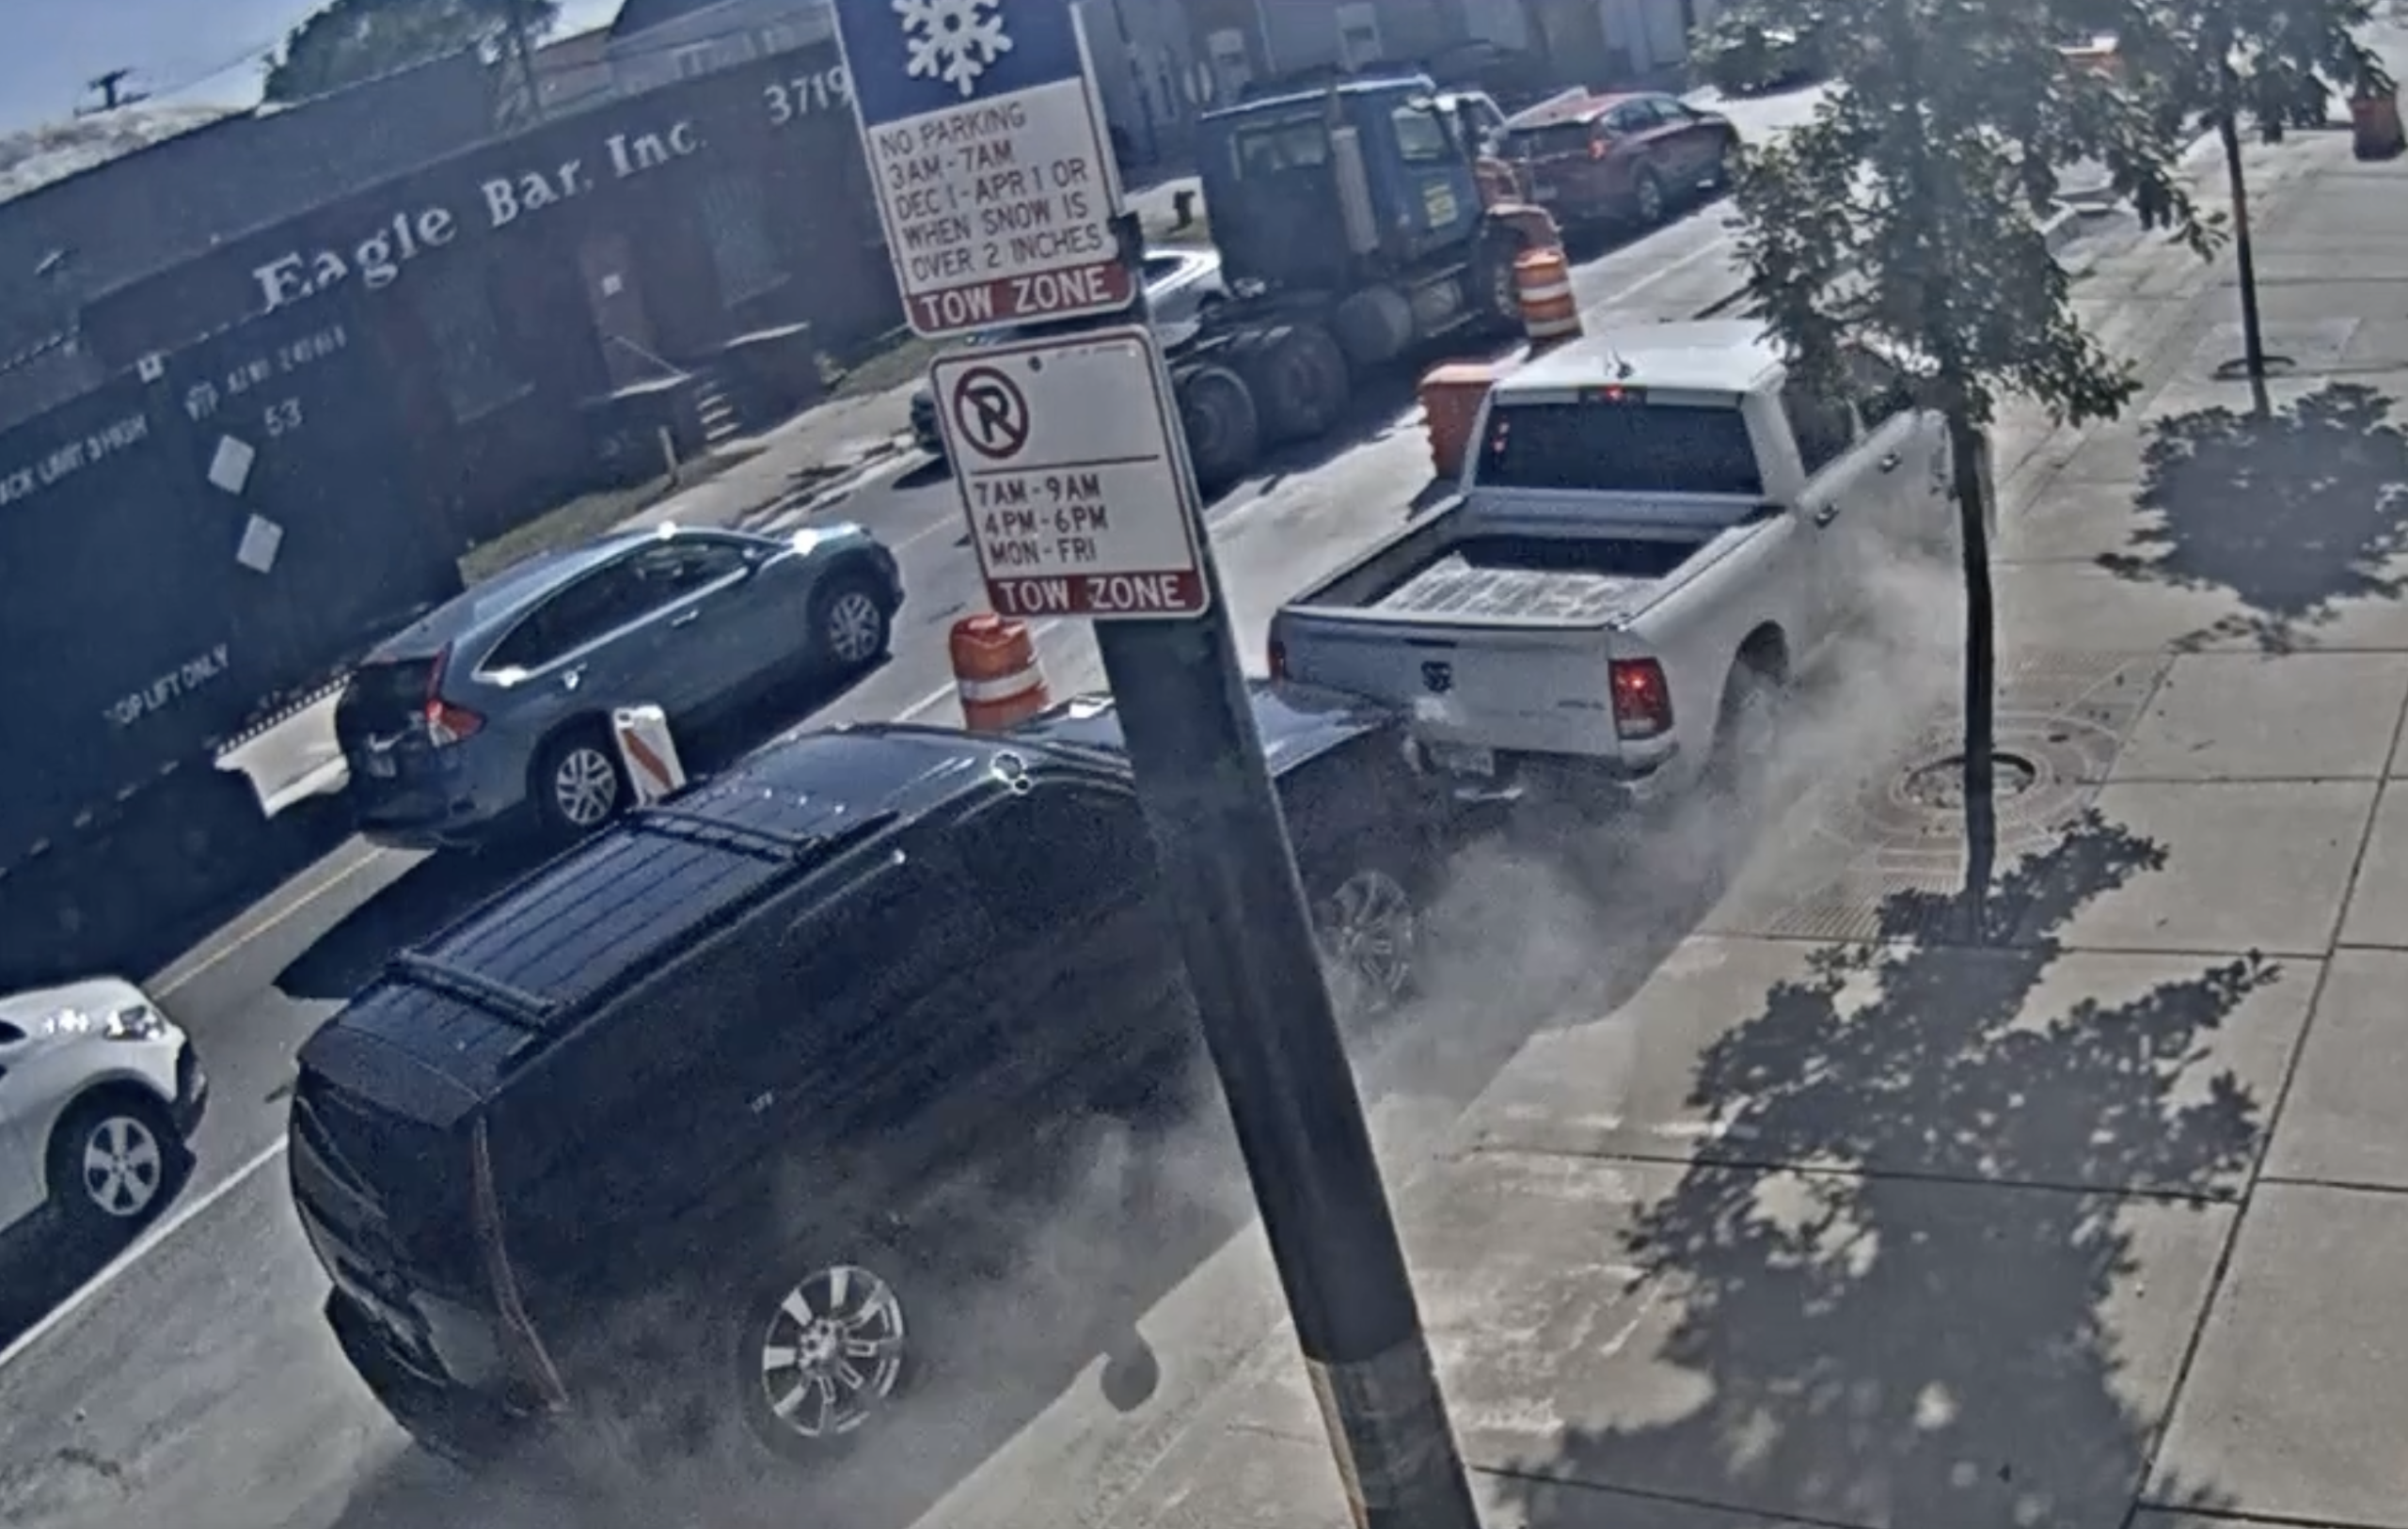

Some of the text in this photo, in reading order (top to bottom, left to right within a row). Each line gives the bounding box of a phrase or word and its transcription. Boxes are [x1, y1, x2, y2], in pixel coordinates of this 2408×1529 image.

[764, 65, 852, 124] 3719
[879, 102, 1026, 158] NO PARKING
[896, 186, 941, 220] DEC
[1052, 158, 1088, 188] OR
[902, 191, 1088, 251] WHEN SNOW IS
[253, 206, 457, 313] Eagle
[911, 224, 1104, 282] OVER 2 INCHES
[920, 266, 1111, 328] TOW ZONE
[264, 397, 304, 437] 53
[998, 575, 1185, 613] TOW ZONE
